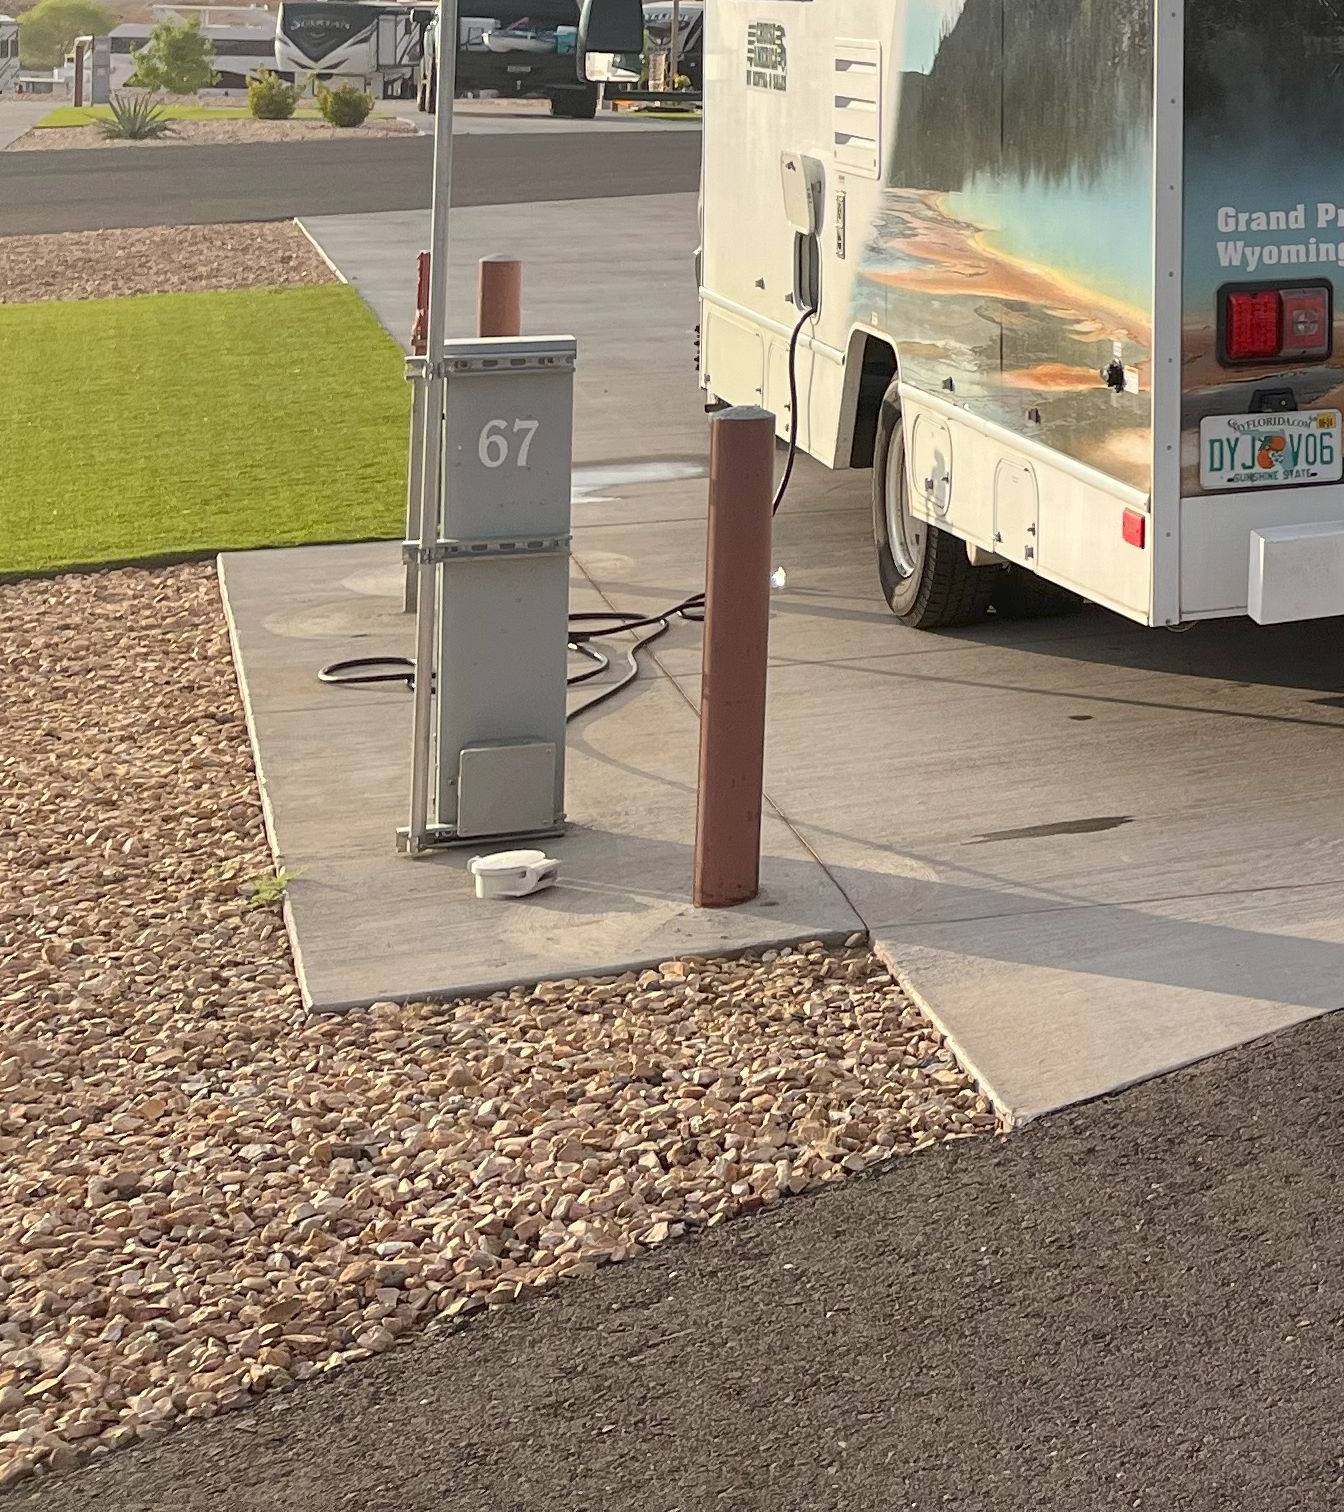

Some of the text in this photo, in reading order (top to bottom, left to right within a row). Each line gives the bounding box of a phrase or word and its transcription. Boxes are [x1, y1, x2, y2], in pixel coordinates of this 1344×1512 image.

[1216, 204, 1305, 233] Grand
[477, 418, 540, 469] 67
[1208, 432, 1335, 472] DYJ V06
[1232, 468, 1312, 483] SUNSHINE STATE
